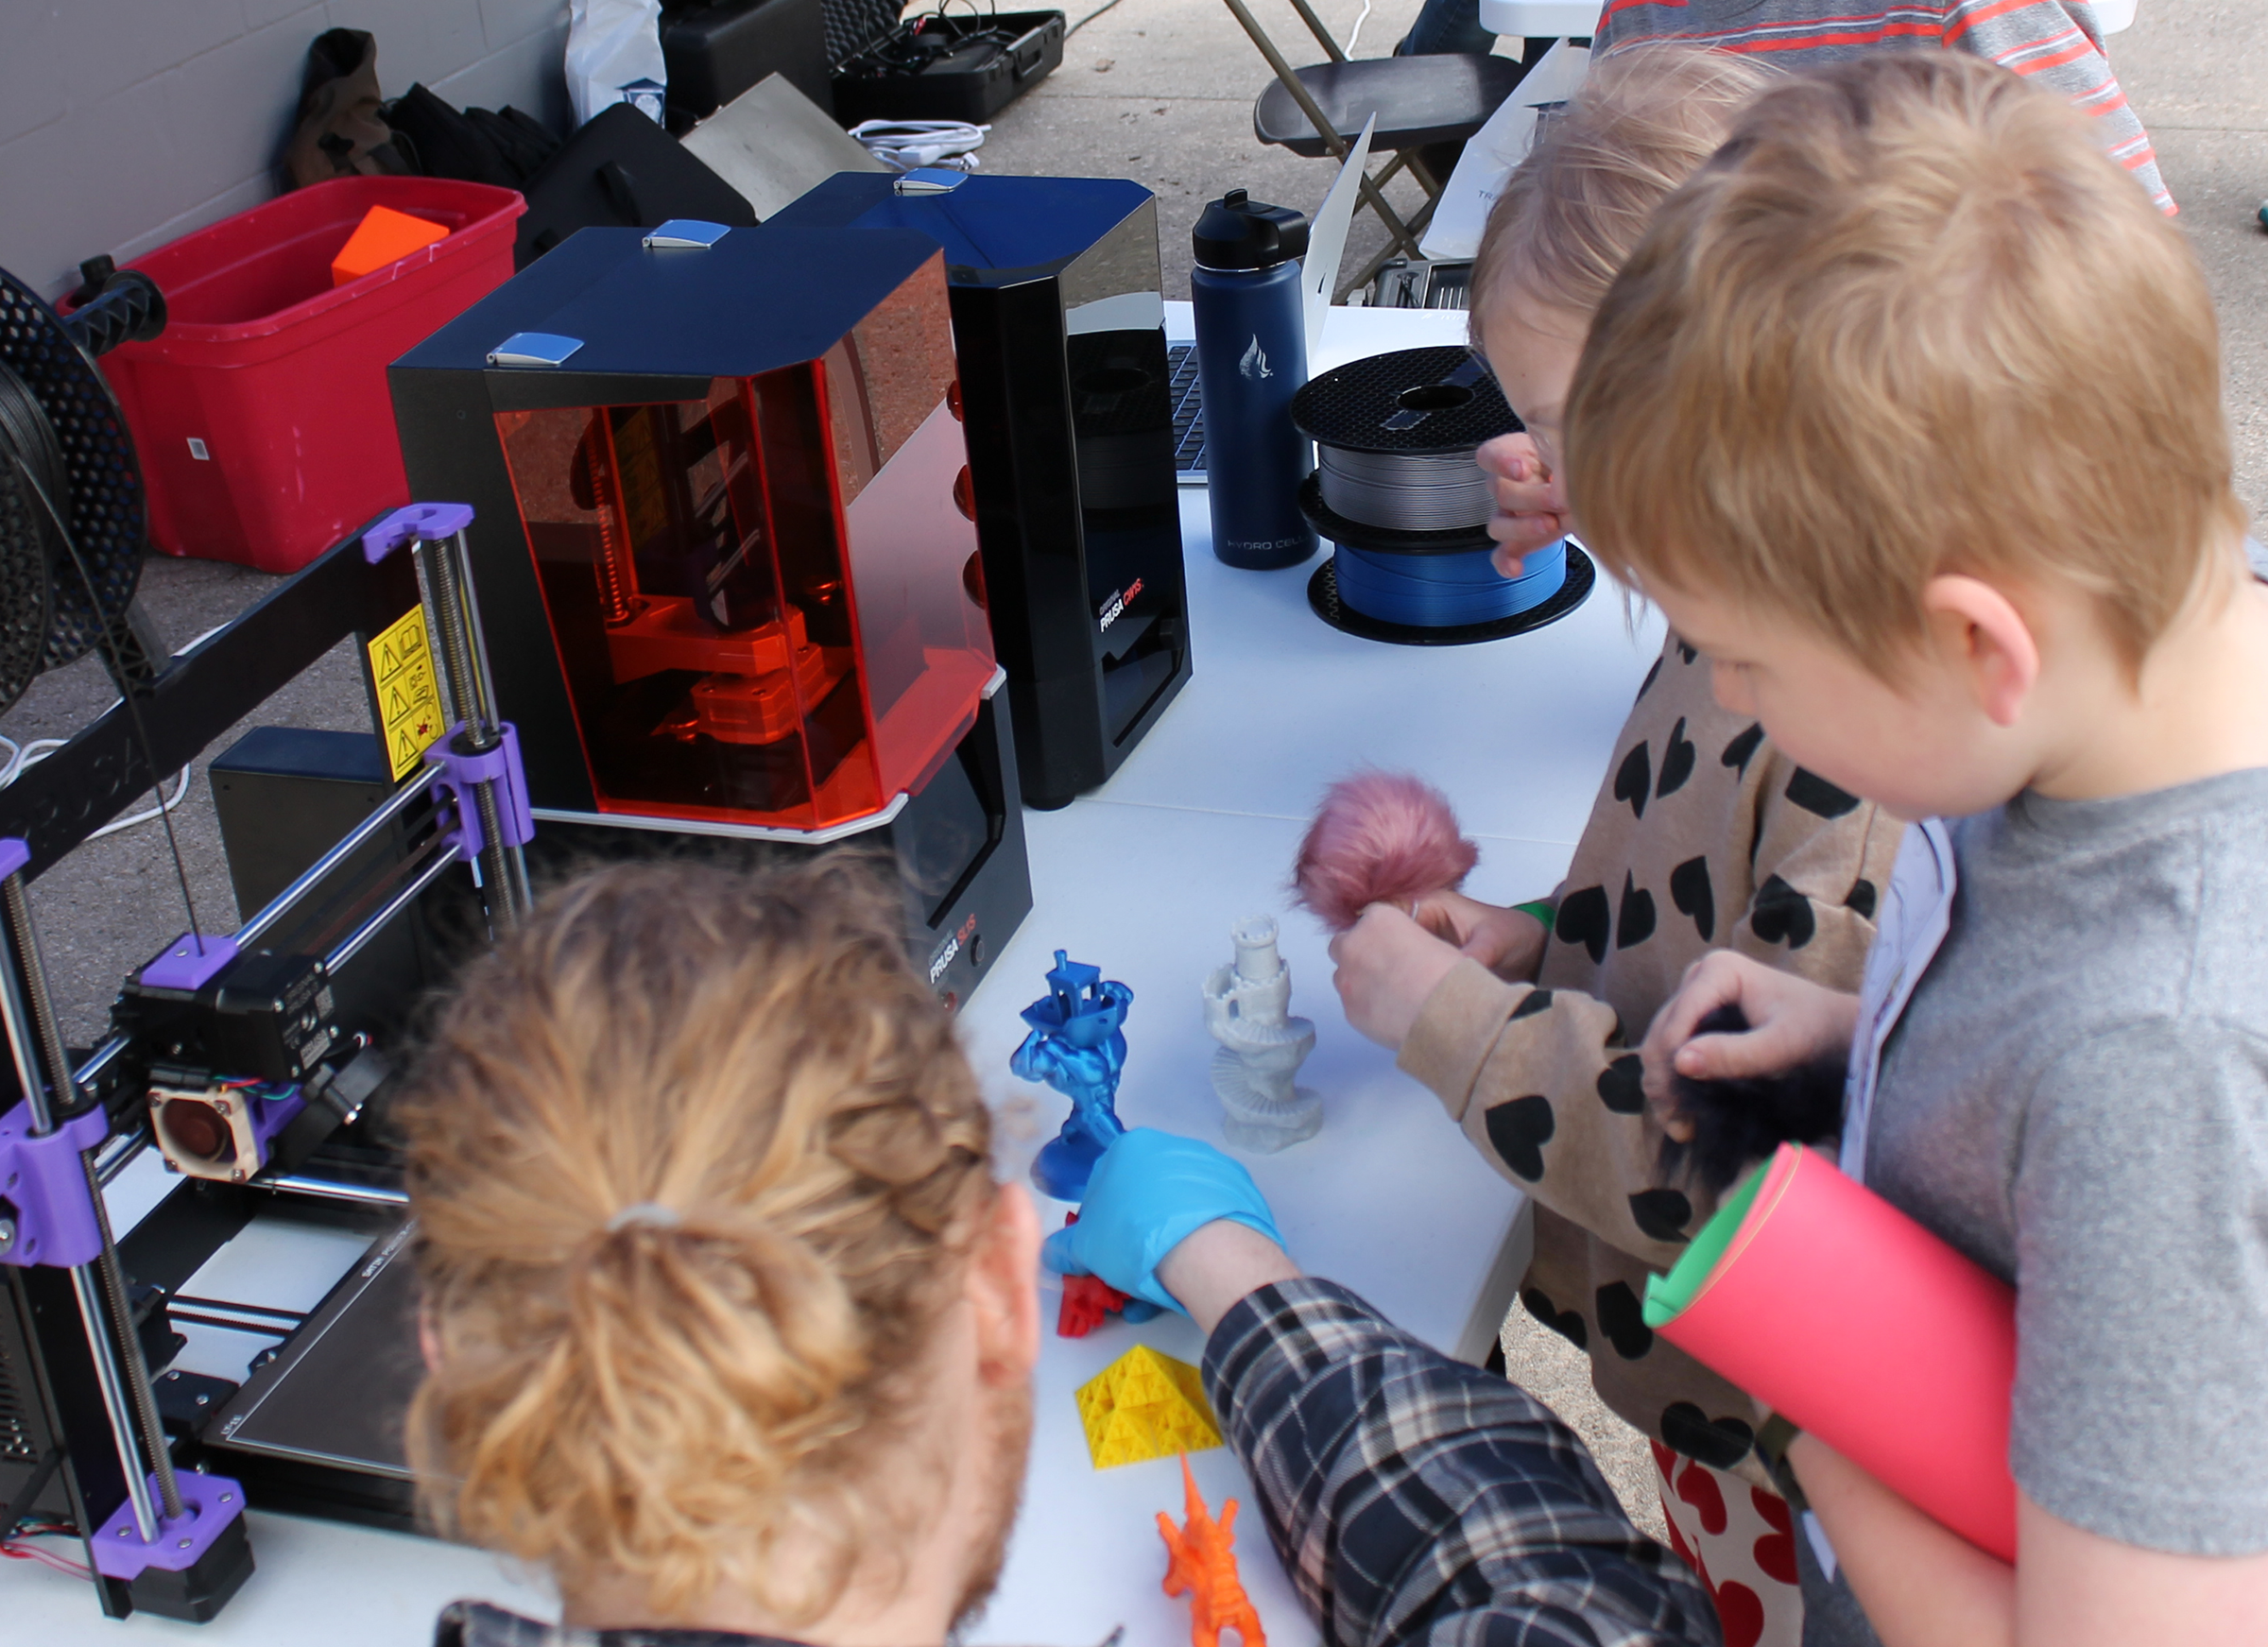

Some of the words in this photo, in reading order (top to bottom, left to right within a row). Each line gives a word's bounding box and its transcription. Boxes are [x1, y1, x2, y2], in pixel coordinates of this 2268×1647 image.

[1228, 540, 1272, 550] HYDRO
[1100, 598, 1124, 632] PRUSA
[930, 938, 959, 984] PRUSA
